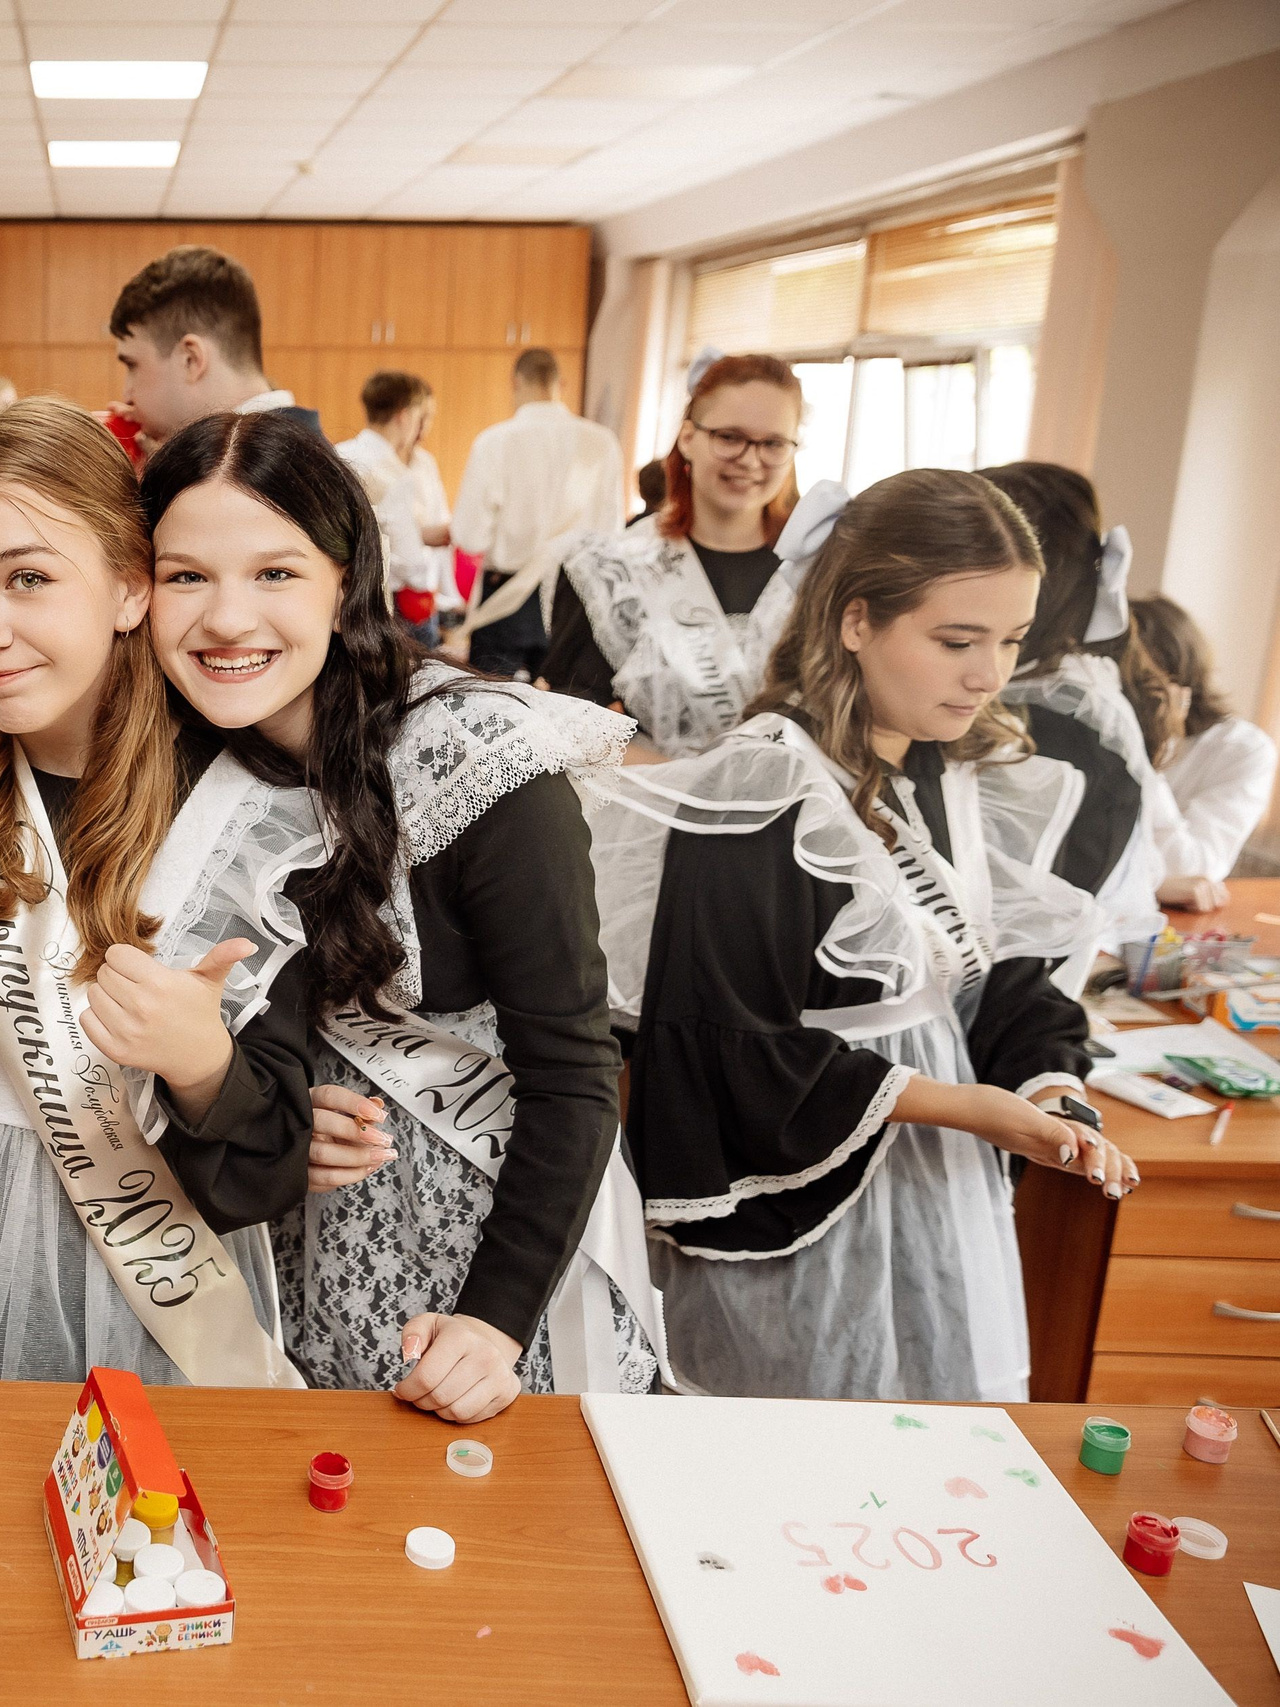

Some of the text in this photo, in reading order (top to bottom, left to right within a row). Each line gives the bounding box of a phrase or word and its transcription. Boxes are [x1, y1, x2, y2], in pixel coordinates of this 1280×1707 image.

[326, 1024, 355, 1049] ицей
[71, 1054, 124, 1151] Голубовская
[73, 1169, 226, 1308] 2025
[76, 1528, 93, 1581] ГУАШЬ
[780, 1520, 998, 1571] 2025
[84, 1626, 137, 1641] ГУАШЬ
[177, 1630, 222, 1642] БЕНИКИ
